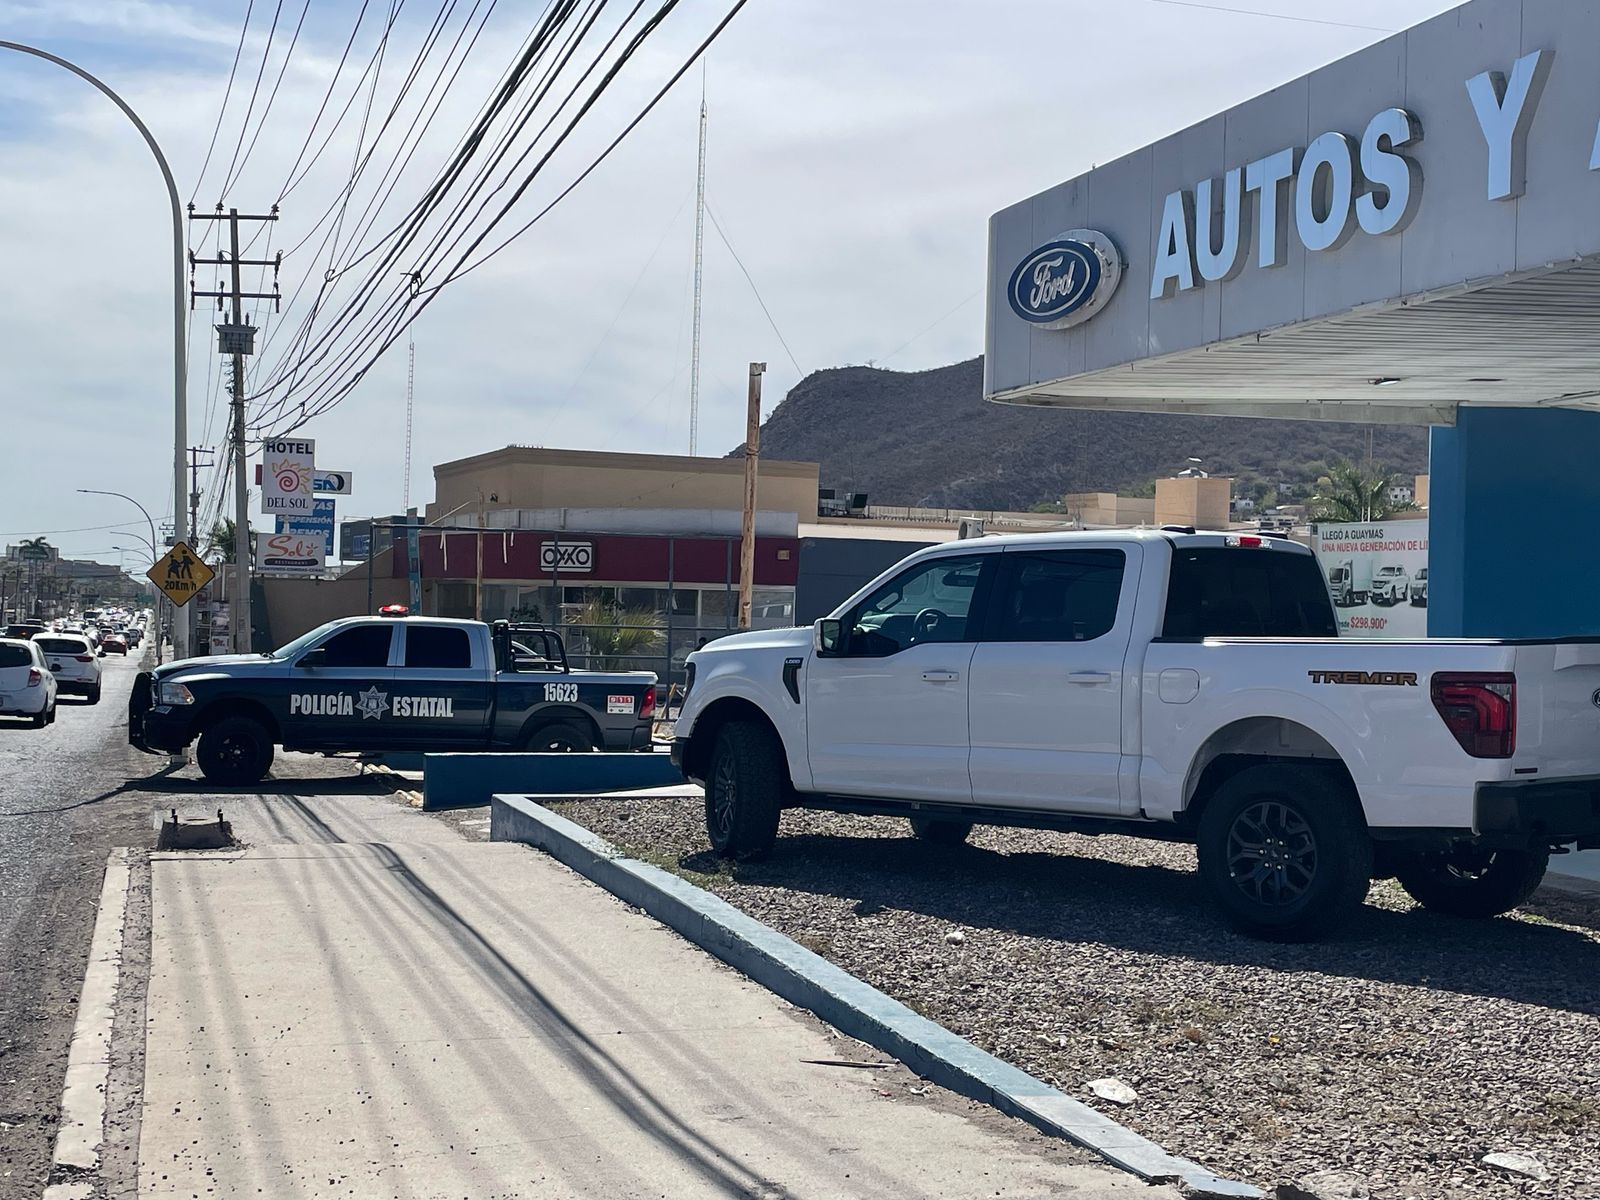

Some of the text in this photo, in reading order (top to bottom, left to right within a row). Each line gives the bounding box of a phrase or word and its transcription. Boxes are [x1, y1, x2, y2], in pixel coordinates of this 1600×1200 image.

[1150, 49, 1554, 299] AUTOS Y
[1030, 255, 1076, 309] Ford
[266, 442, 313, 454] HOTEL
[267, 497, 309, 509] DEL SOL
[277, 515, 334, 525] SSPENSIÓN
[1322, 528, 1384, 540] LLEGÓ A GUAYMAS
[1322, 542, 1335, 552] UNA
[1337, 542, 1358, 552] NUEVA
[1360, 539, 1406, 552] GENERACIÓN
[1407, 540, 1417, 551] DE
[543, 547, 590, 565] OXXO
[1308, 670, 1418, 686] TREMOR
[543, 683, 578, 702] 15623
[290, 691, 454, 718] POLICÍA ESTATAL
